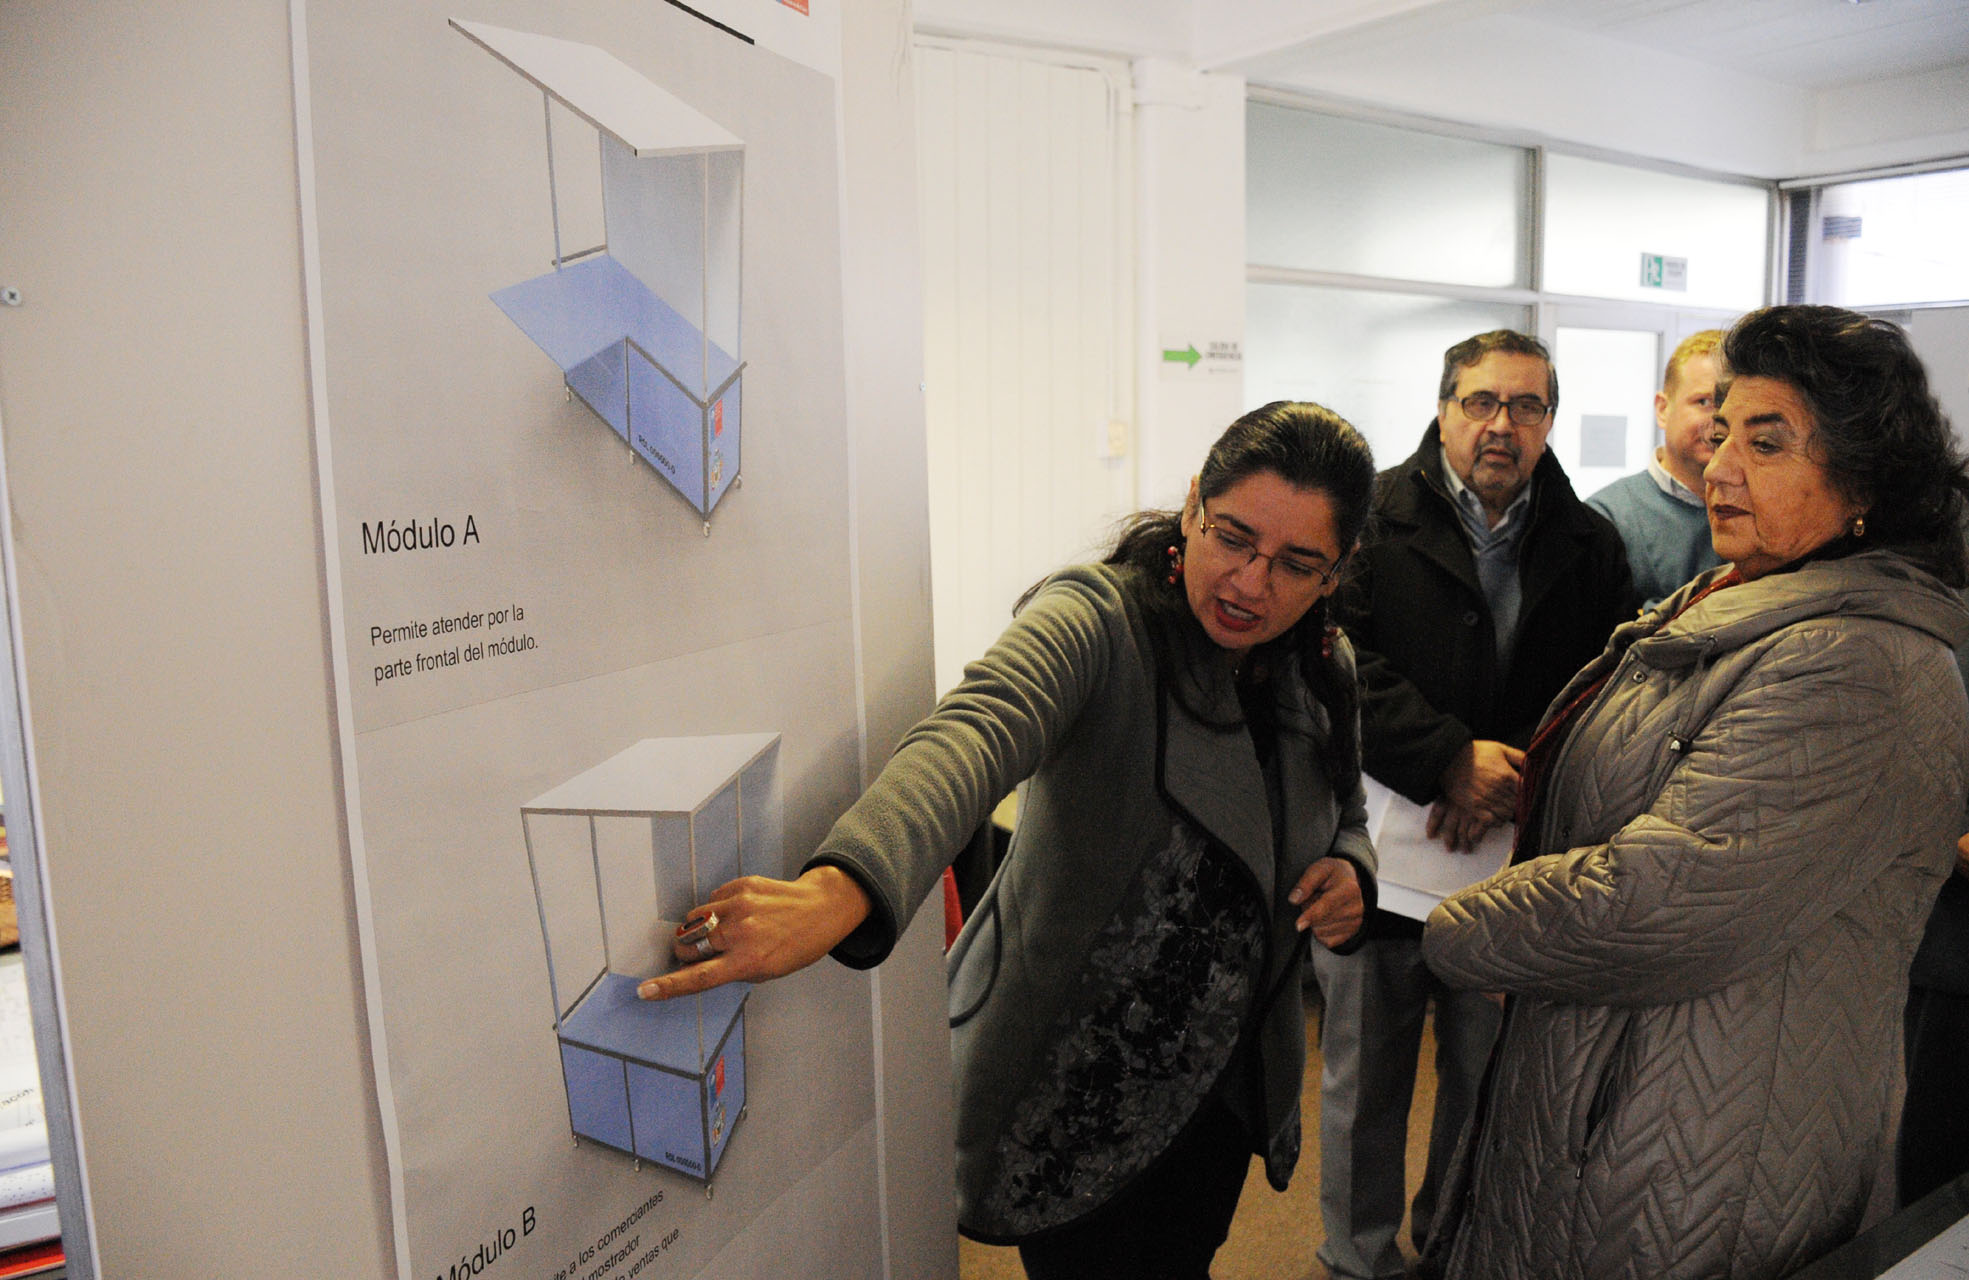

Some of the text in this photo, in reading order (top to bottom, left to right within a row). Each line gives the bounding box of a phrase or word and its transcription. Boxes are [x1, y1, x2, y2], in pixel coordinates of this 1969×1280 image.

[362, 515, 480, 554] Módulo A
[370, 604, 524, 646] Permite atender por la
[374, 634, 539, 686] parte frontal del módulo.
[521, 1206, 536, 1237] B
[569, 1261, 576, 1275] a
[578, 1246, 595, 1266] los
[597, 1190, 664, 1251] comerciantes
[628, 1228, 679, 1279] ventas que
